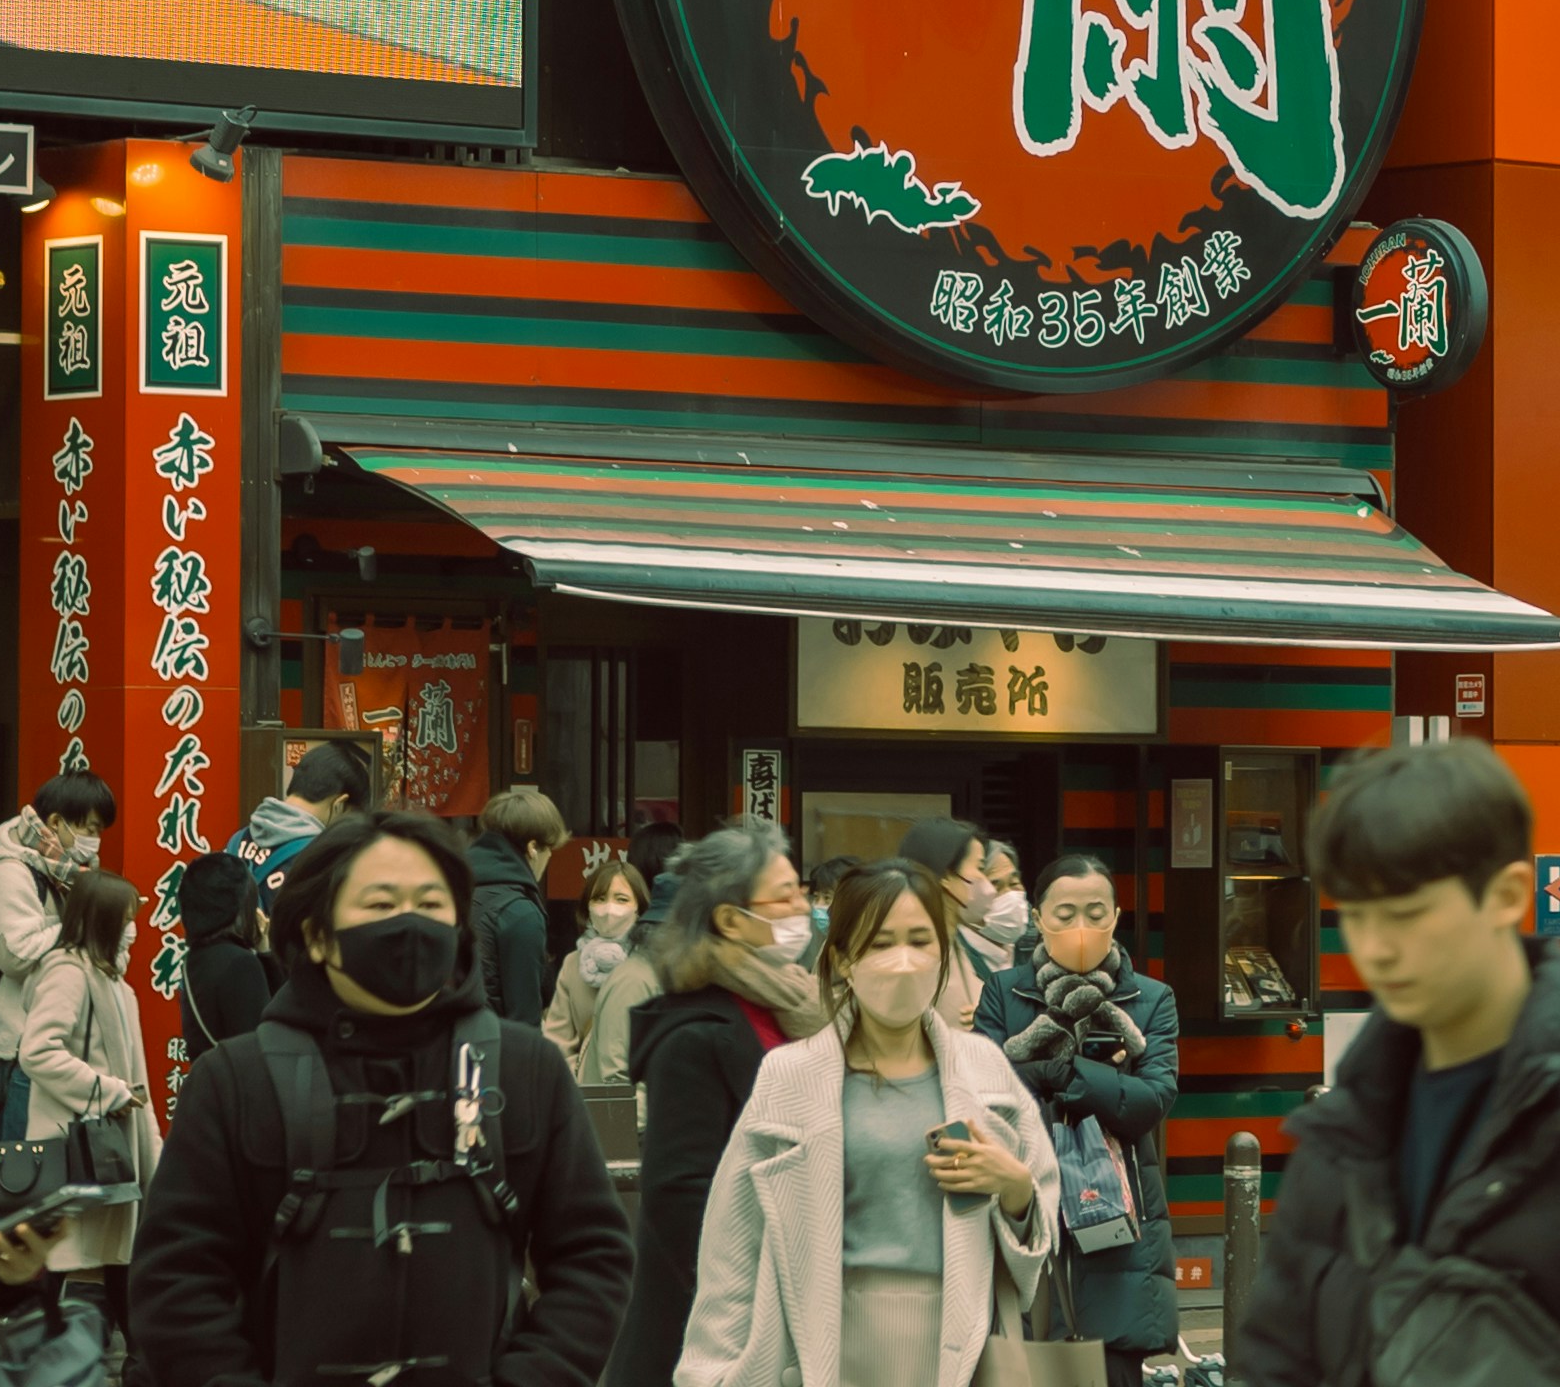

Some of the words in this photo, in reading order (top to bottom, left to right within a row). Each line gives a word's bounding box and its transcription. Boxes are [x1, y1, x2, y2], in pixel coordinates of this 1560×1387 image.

[58, 262, 92, 376] 元祖
[160, 258, 211, 372] 元祖
[928, 229, 1254, 348] 昭和35年創業
[1356, 248, 1449, 357] 一蘭
[362, 678, 458, 754] 一蘭
[901, 661, 1049, 717] 販売所
